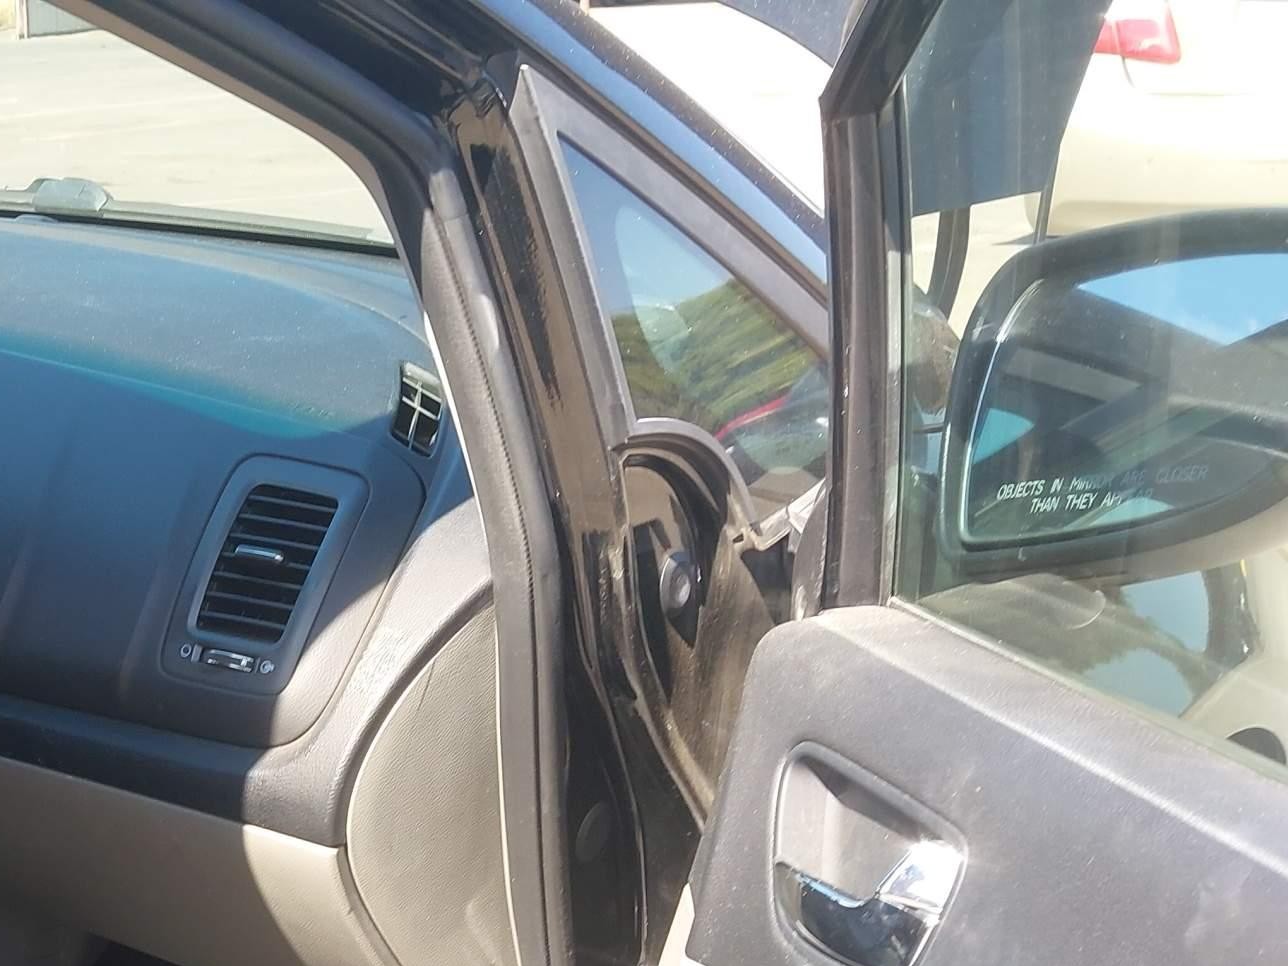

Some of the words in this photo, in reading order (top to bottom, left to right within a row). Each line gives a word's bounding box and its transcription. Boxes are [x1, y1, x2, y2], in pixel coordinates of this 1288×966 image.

[996, 479, 1045, 501] OBJECTS
[1050, 478, 1065, 494] IN
[1156, 464, 1209, 483] CLOSER
[1029, 497, 1060, 514] THAN
[1064, 493, 1099, 511] THEY
[1101, 488, 1153, 508] APAR
